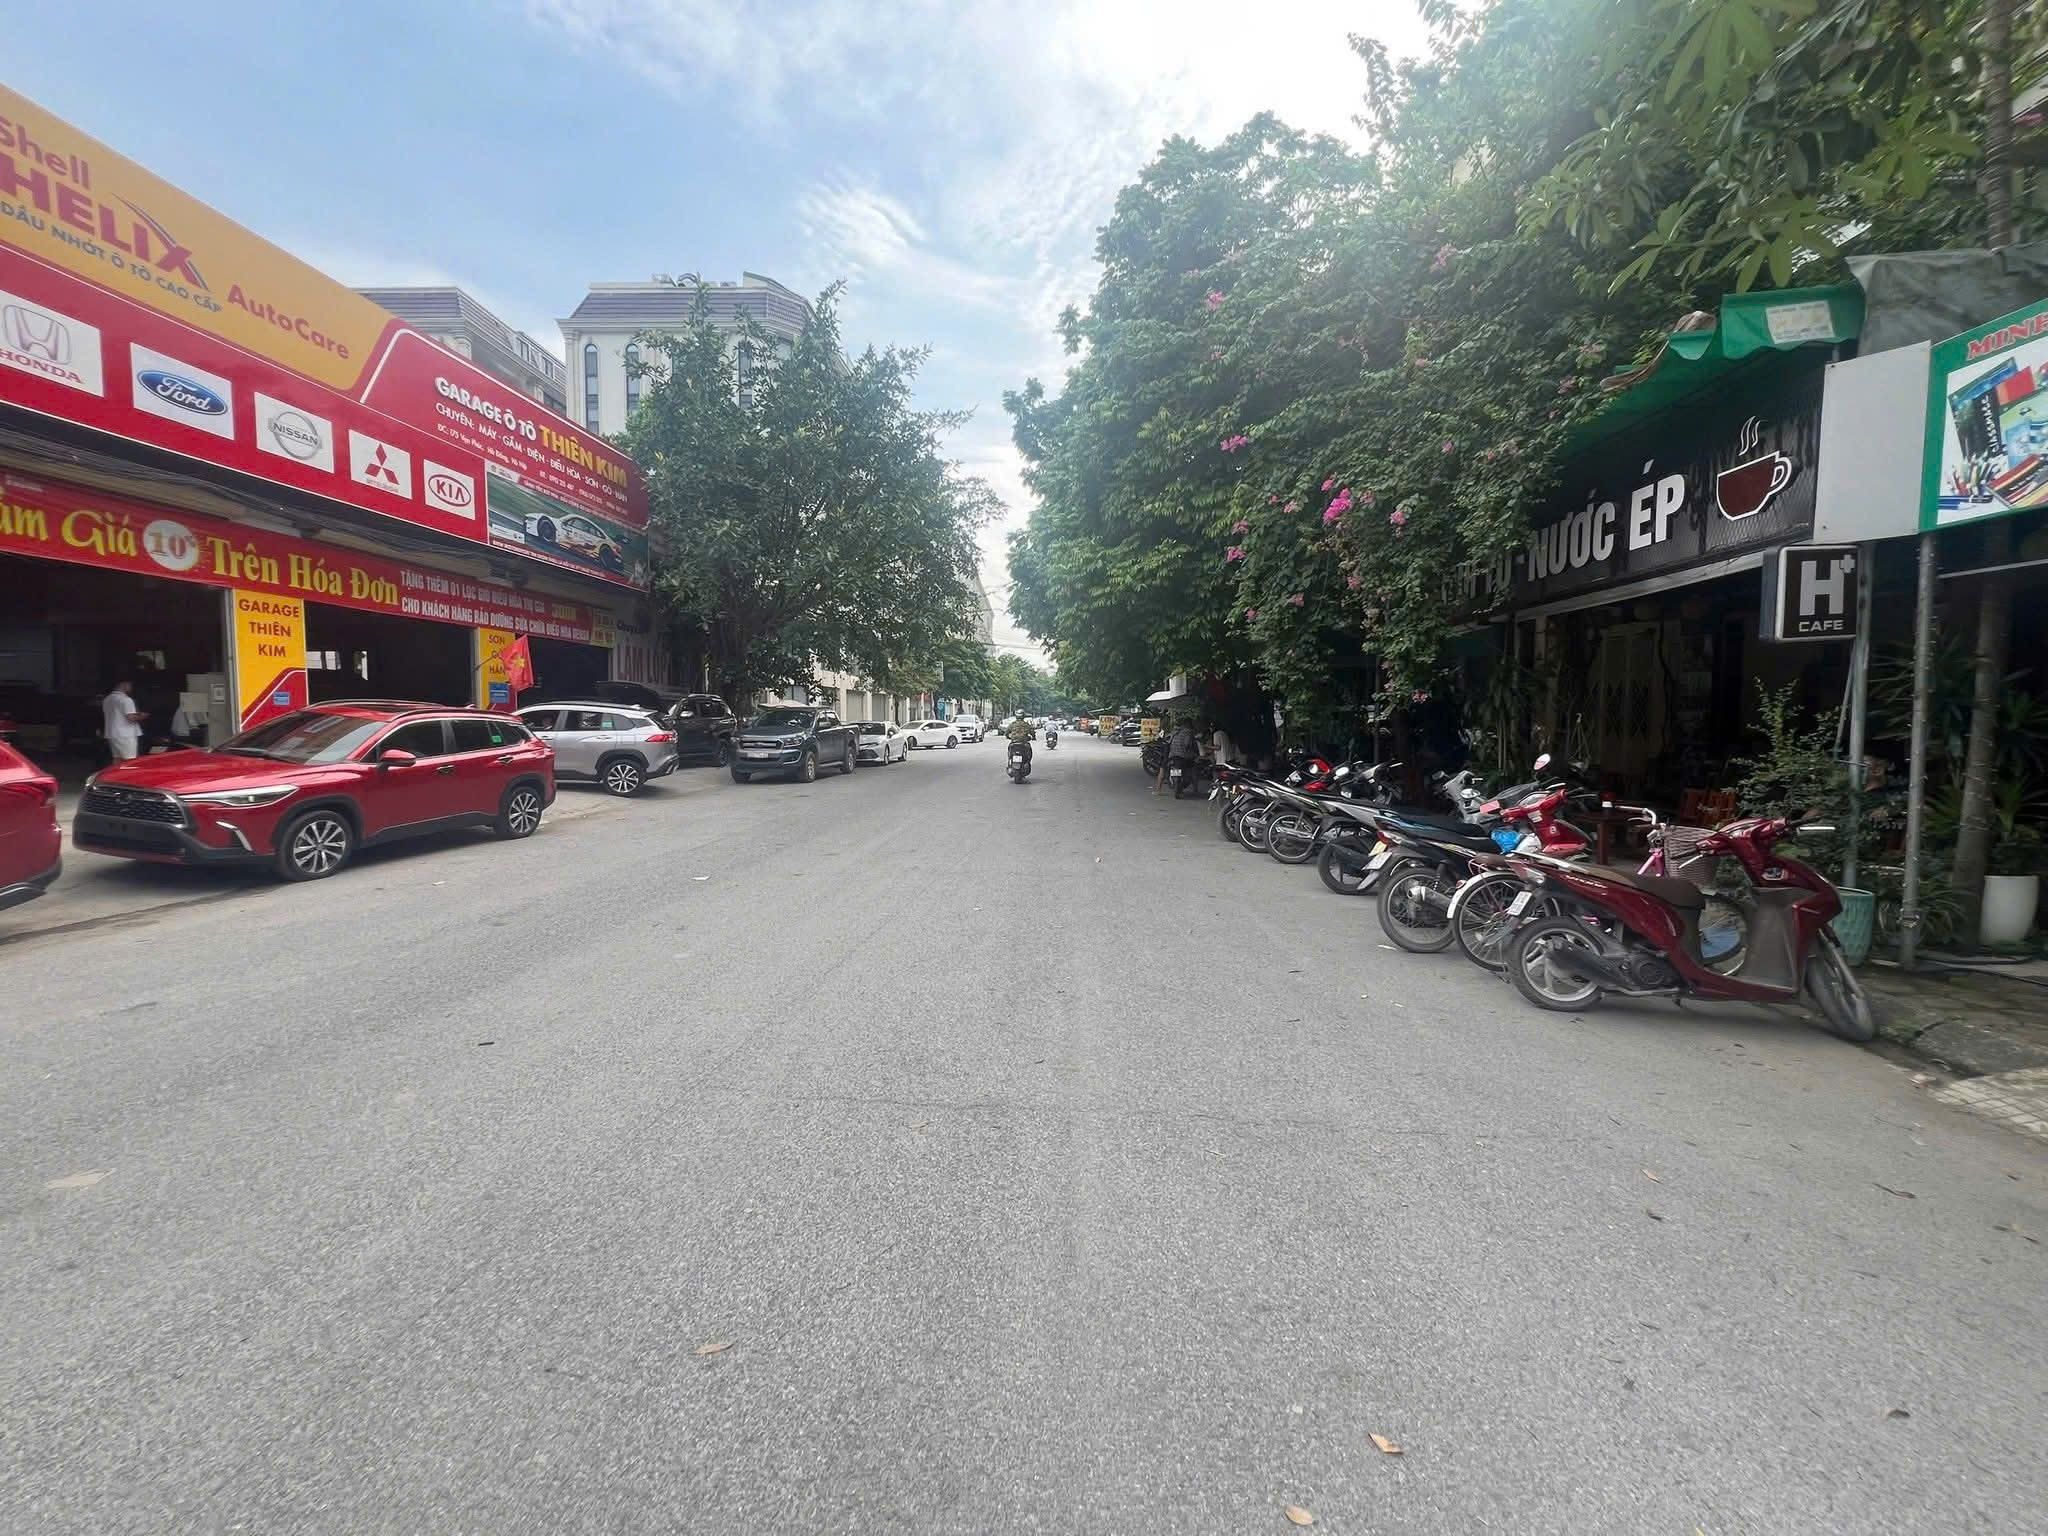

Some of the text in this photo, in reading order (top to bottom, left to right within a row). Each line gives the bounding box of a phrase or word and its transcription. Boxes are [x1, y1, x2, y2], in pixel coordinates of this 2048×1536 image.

[0, 115, 90, 191] Shell
[0, 150, 209, 292] HELIX
[156, 276, 189, 300] CAO
[227, 284, 350, 360] AutoCare
[0, 348, 83, 384] HONDA
[156, 376, 212, 412] Ford
[272, 421, 320, 446] NISSAN
[434, 376, 503, 424] GARAGE
[518, 419, 537, 441] TÔ
[539, 424, 594, 471] THIÊN
[595, 456, 629, 488] KIM
[436, 478, 465, 503] KIA
[1527, 488, 1616, 582] NƯỚC
[1629, 458, 1686, 551] ÉP
[61, 509, 138, 557] Giá
[206, 536, 281, 585] Trên
[288, 552, 344, 596] Hóa
[350, 566, 399, 606] Đơn
[238, 598, 300, 618] GARAGE
[401, 597, 420, 615] CHO
[422, 600, 450, 620] KHÁCH
[248, 621, 291, 637] THIÊN
[1799, 619, 1844, 632] CAFE
[258, 644, 287, 657] KIM
